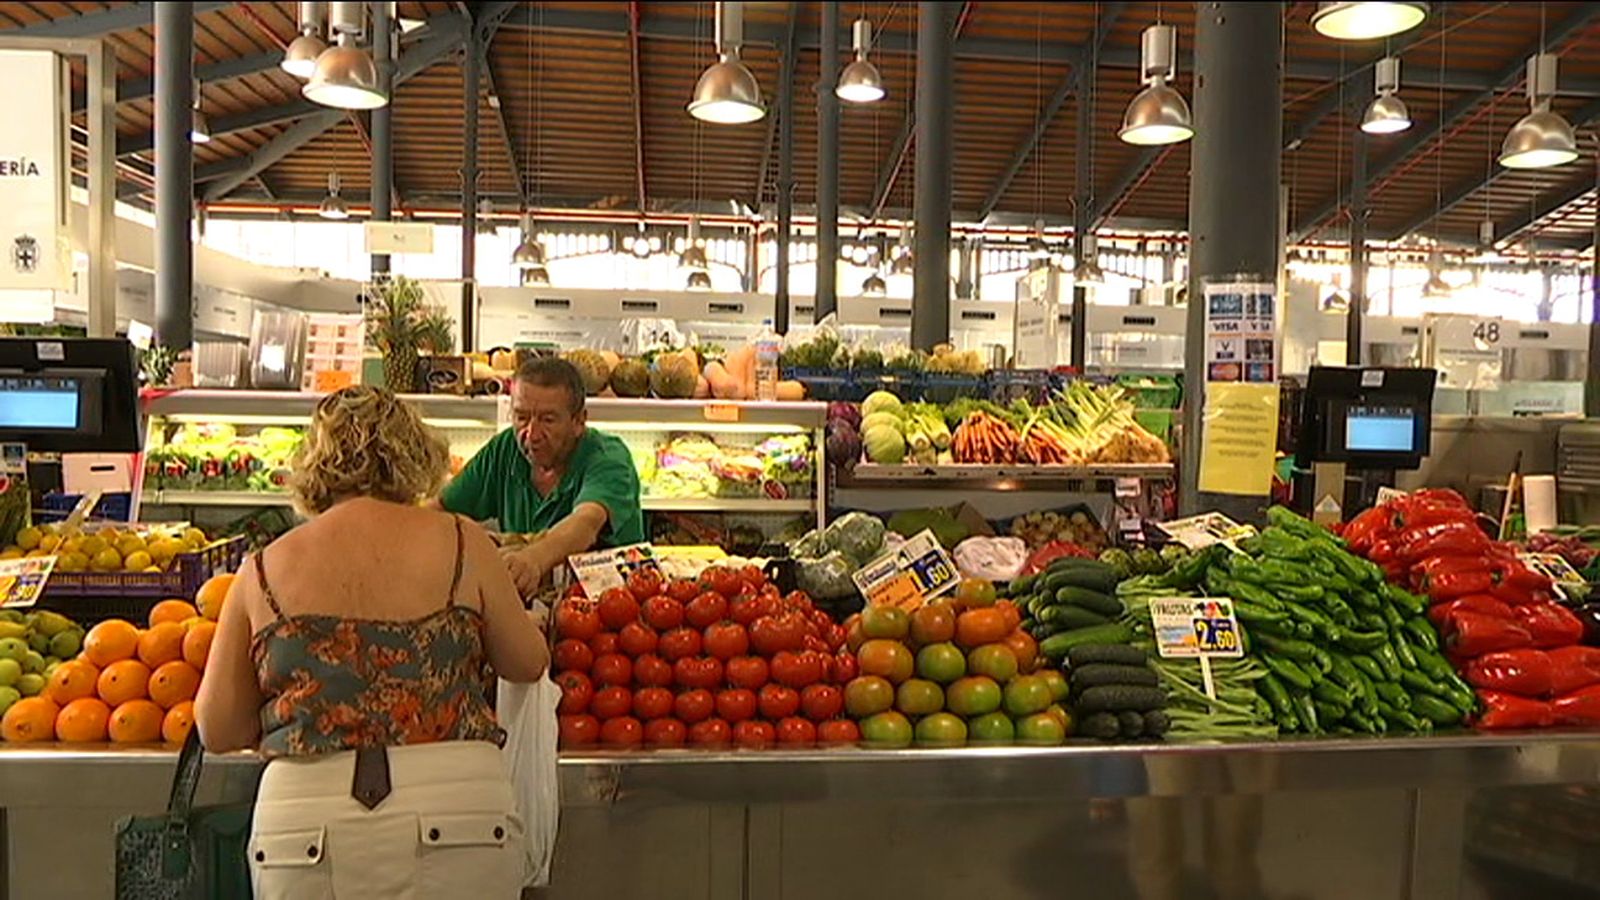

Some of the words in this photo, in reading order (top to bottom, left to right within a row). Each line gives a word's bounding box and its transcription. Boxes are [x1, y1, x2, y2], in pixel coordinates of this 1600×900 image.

[0, 156, 39, 176] ERÍA
[1213, 322, 1239, 332] VISA
[1473, 322, 1500, 343] 48
[651, 330, 670, 345] 14
[1196, 620, 1236, 649] 2.60
